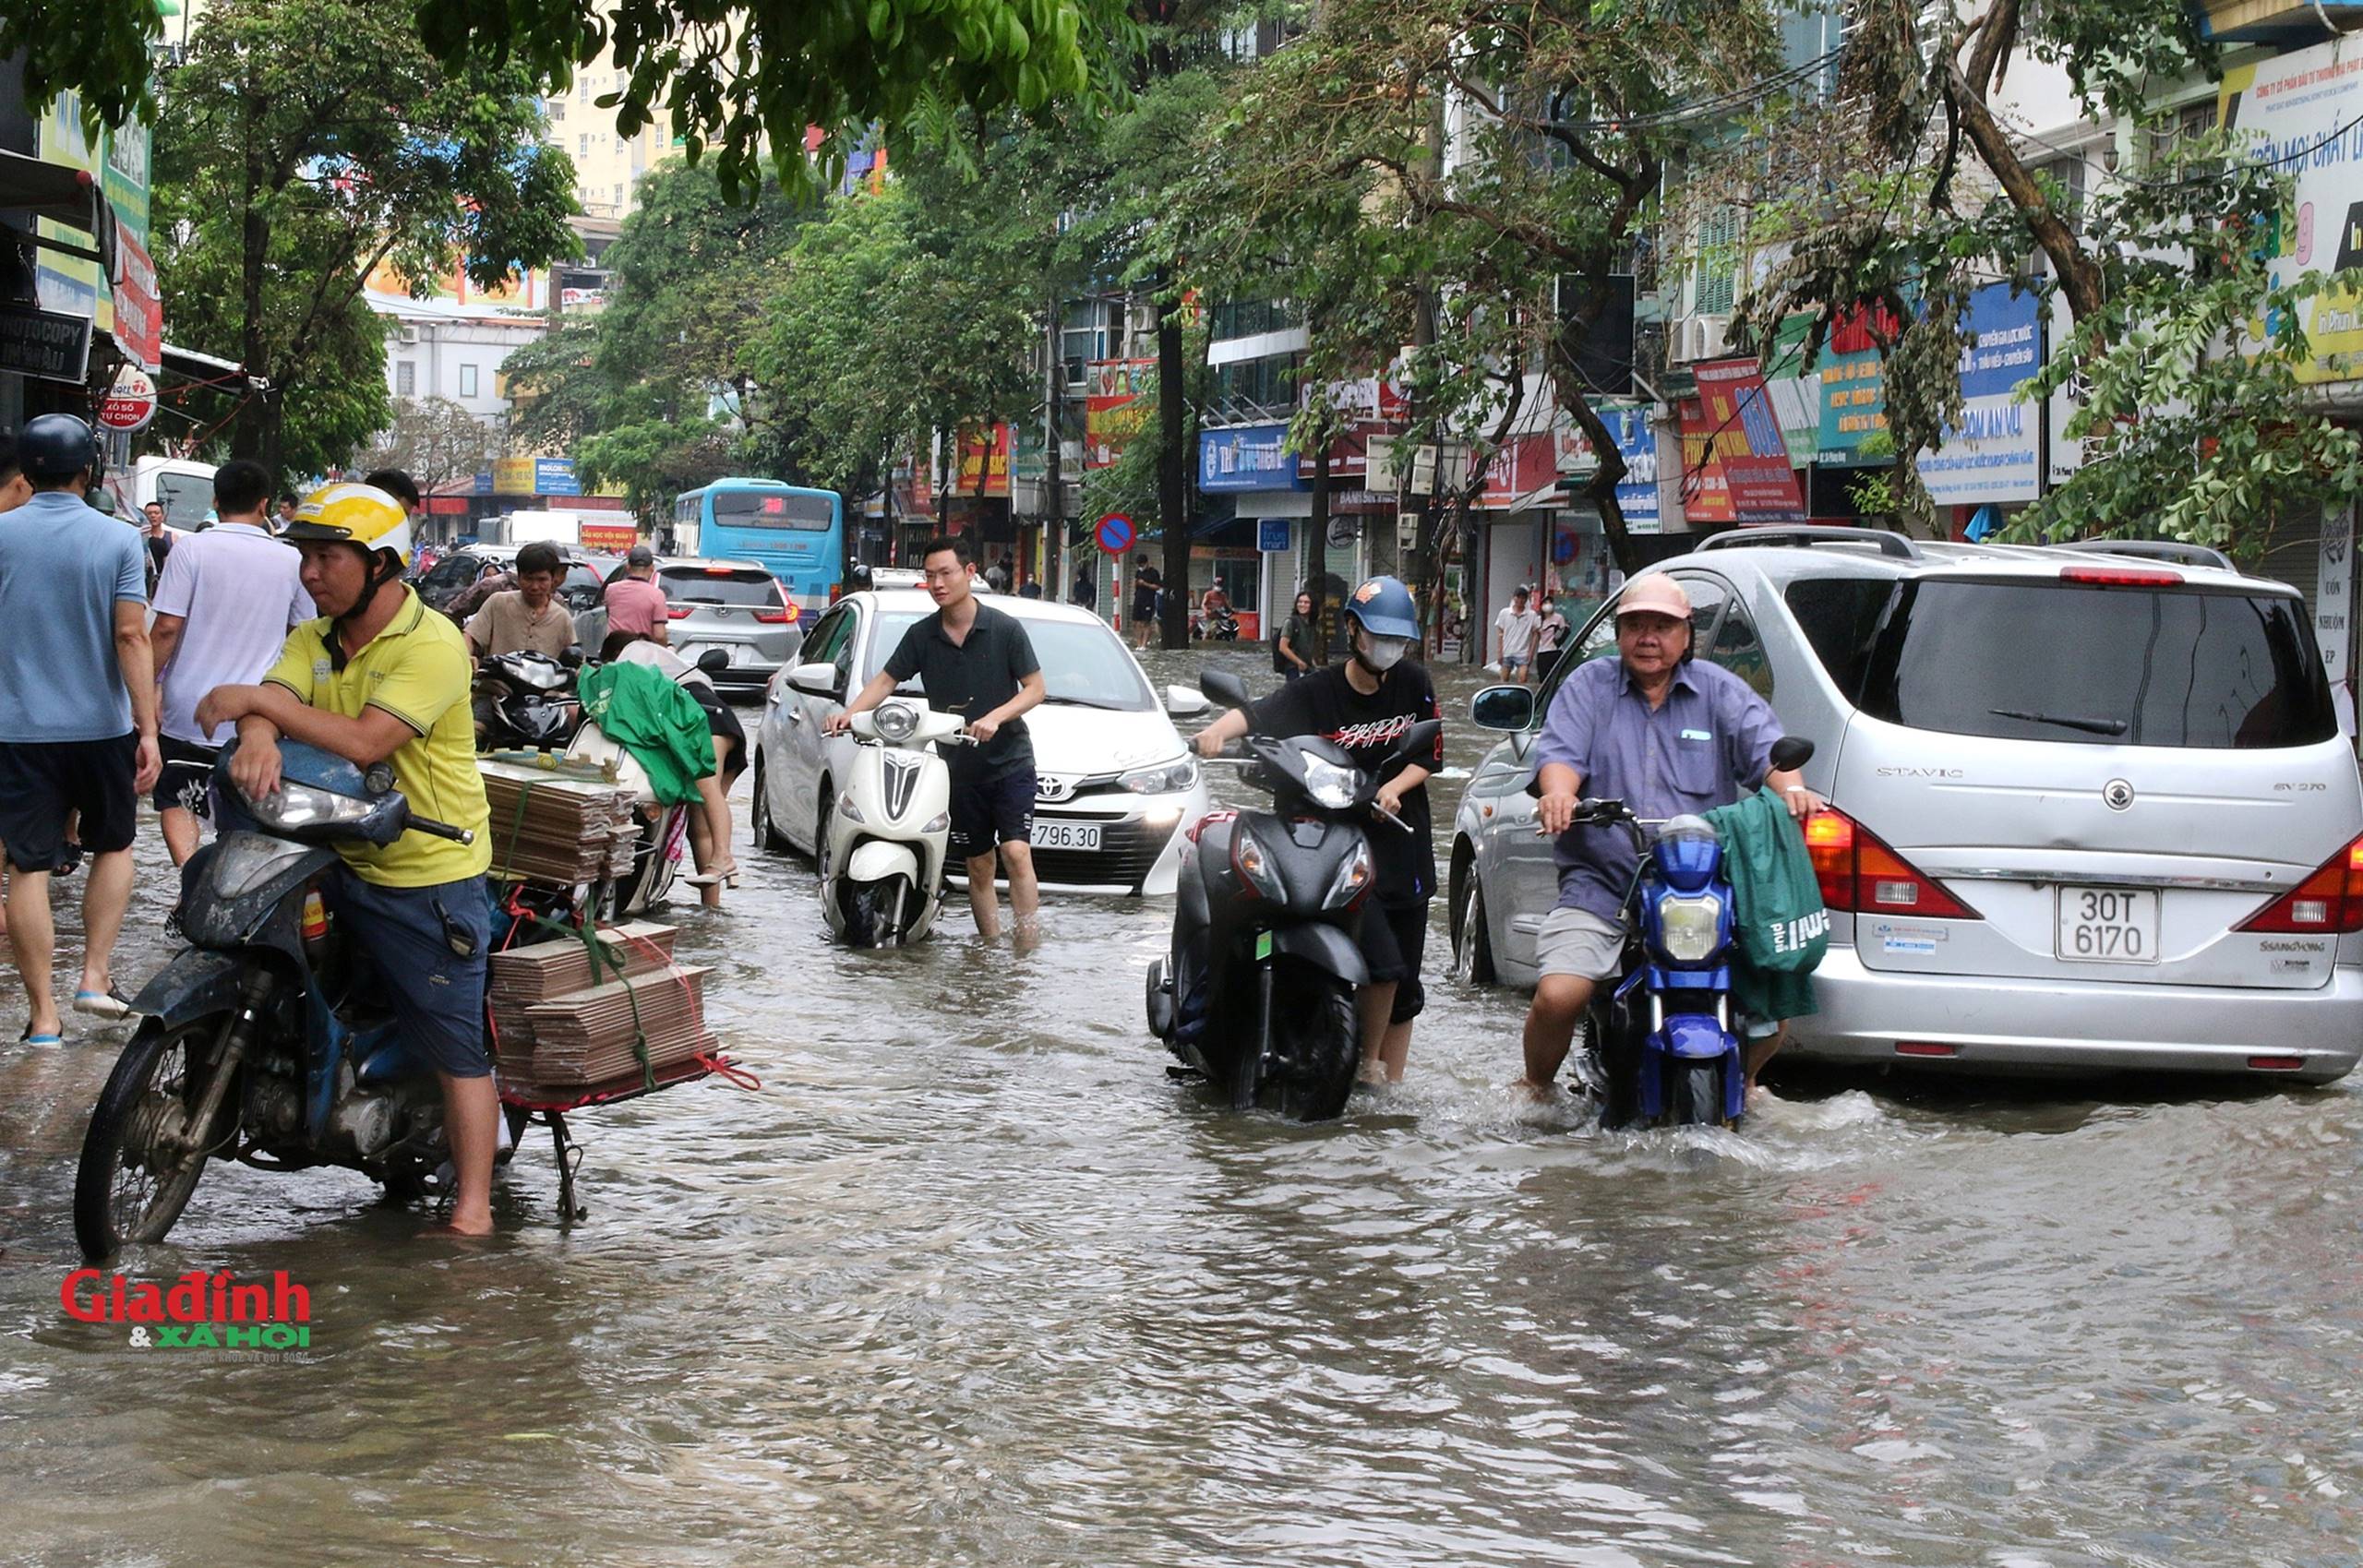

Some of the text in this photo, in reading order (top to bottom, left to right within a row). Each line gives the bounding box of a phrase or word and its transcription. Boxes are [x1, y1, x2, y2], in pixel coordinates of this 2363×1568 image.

[1876, 767, 1964, 779] STAVIC
[2297, 782, 2326, 792] 270
[2081, 891, 2137, 923] 30T
[2075, 924, 2141, 956] 6170
